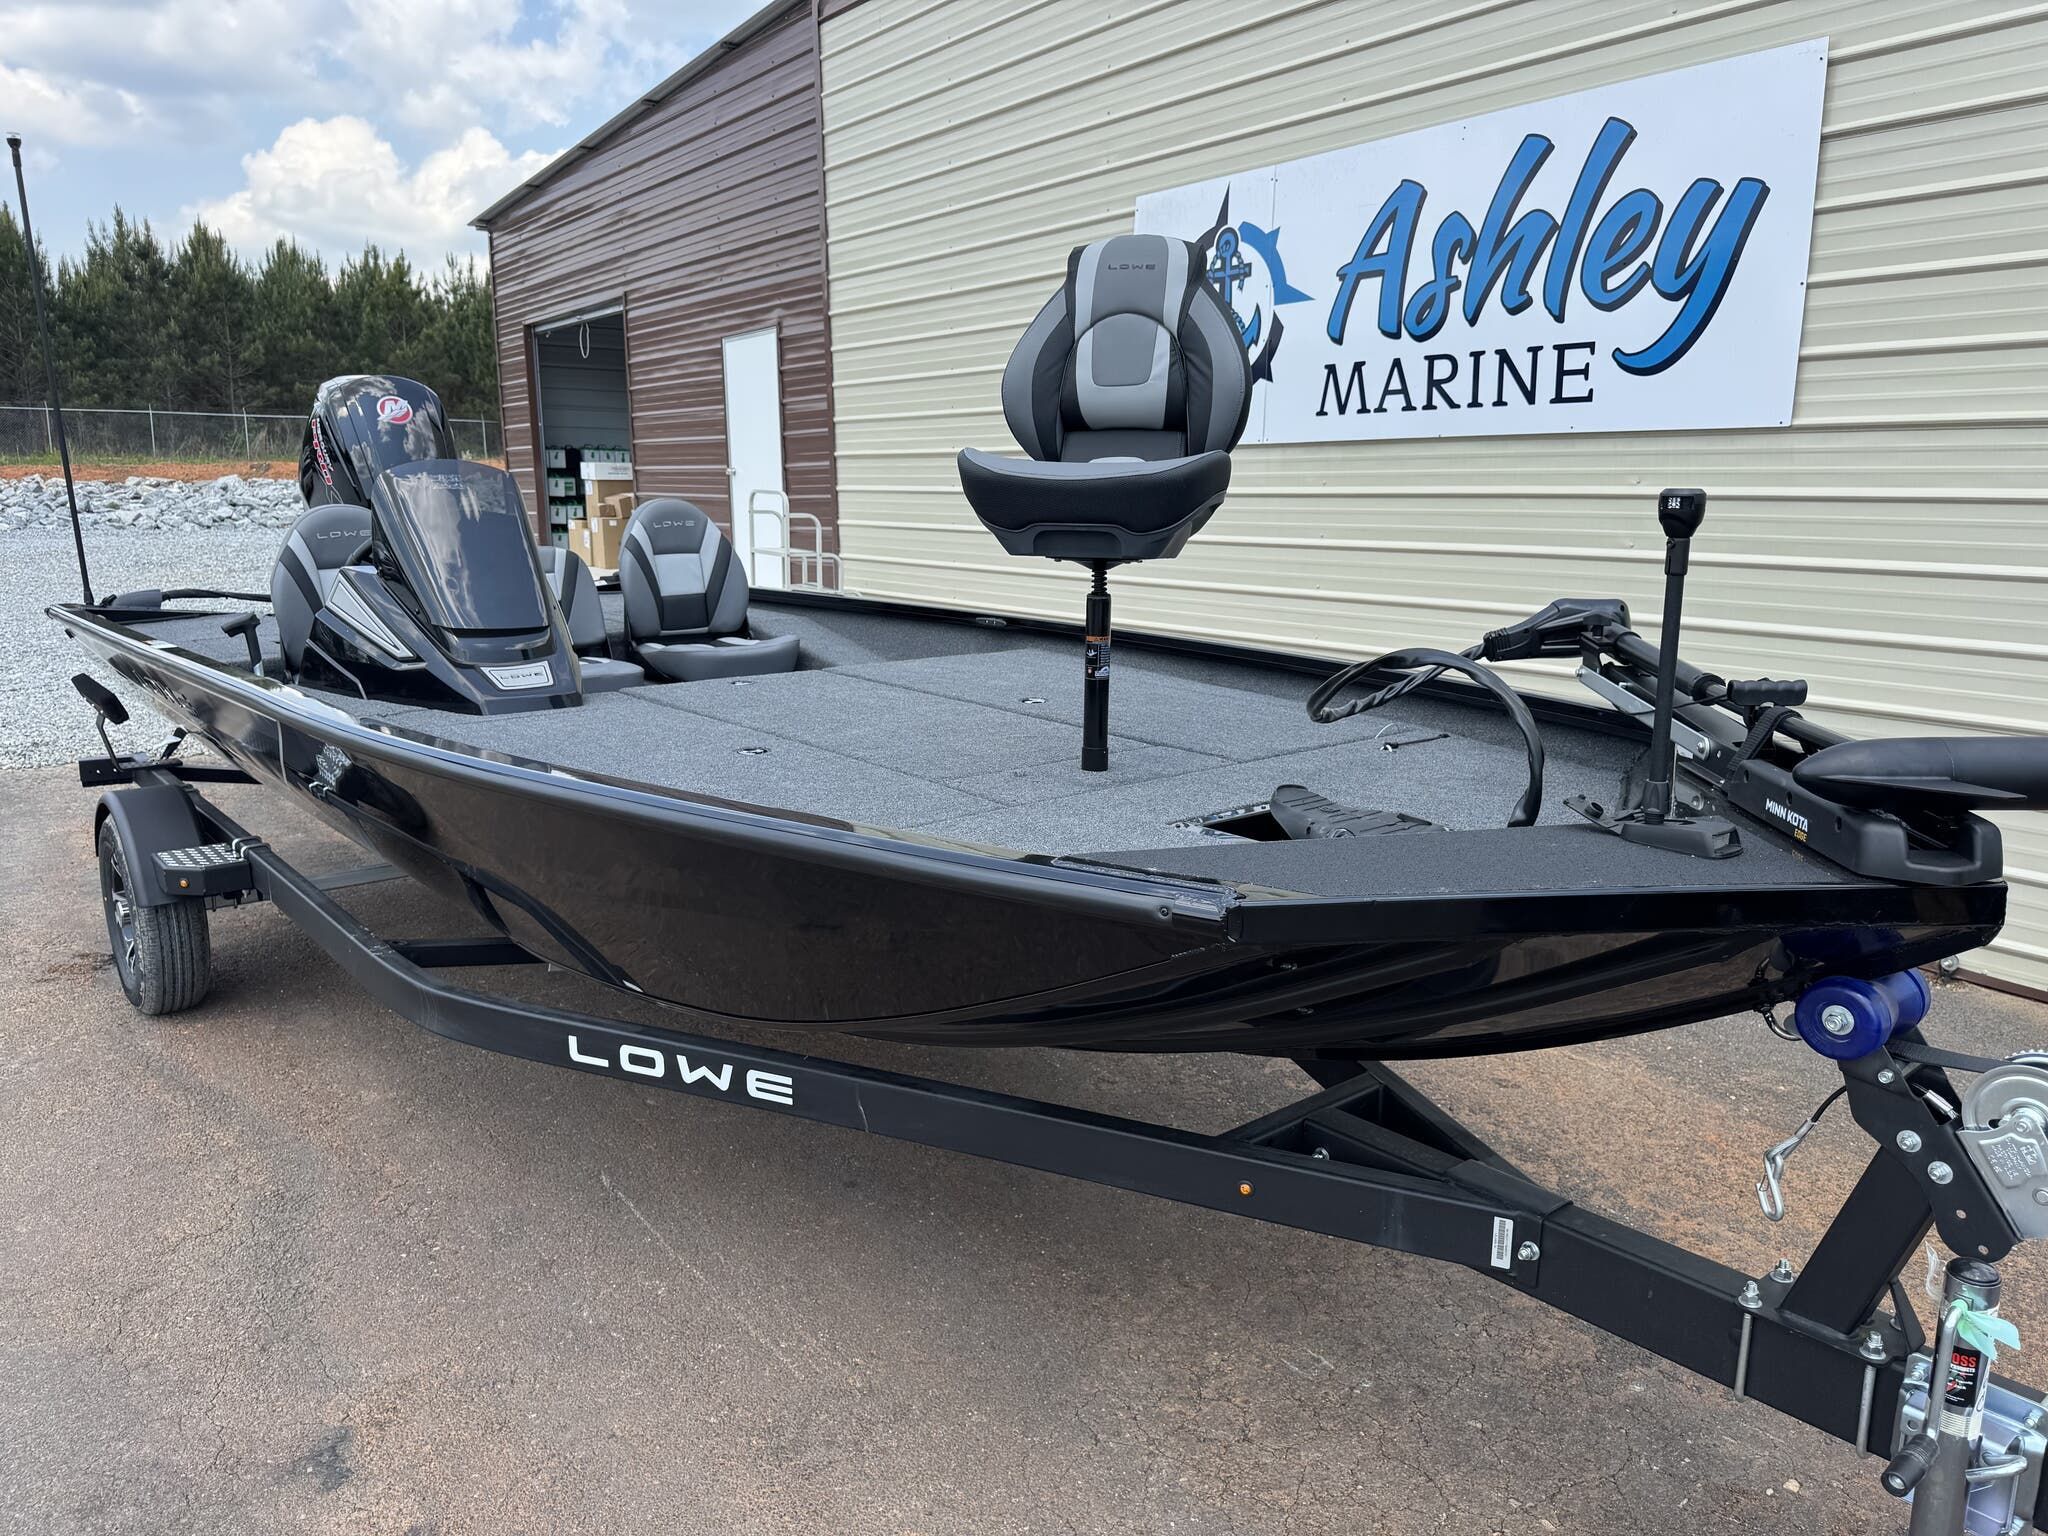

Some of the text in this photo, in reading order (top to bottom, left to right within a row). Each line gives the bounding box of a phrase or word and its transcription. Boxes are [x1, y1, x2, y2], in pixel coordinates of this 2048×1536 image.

[1327, 116, 1770, 376] Ashley
[1315, 341, 1596, 416] MARINE
[316, 529, 373, 540] LOWE
[653, 520, 696, 528] LOWE
[1765, 797, 1808, 833] MINN KOTA
[568, 1035, 793, 1106] LOWE
[1951, 1353, 1977, 1368] OSS
